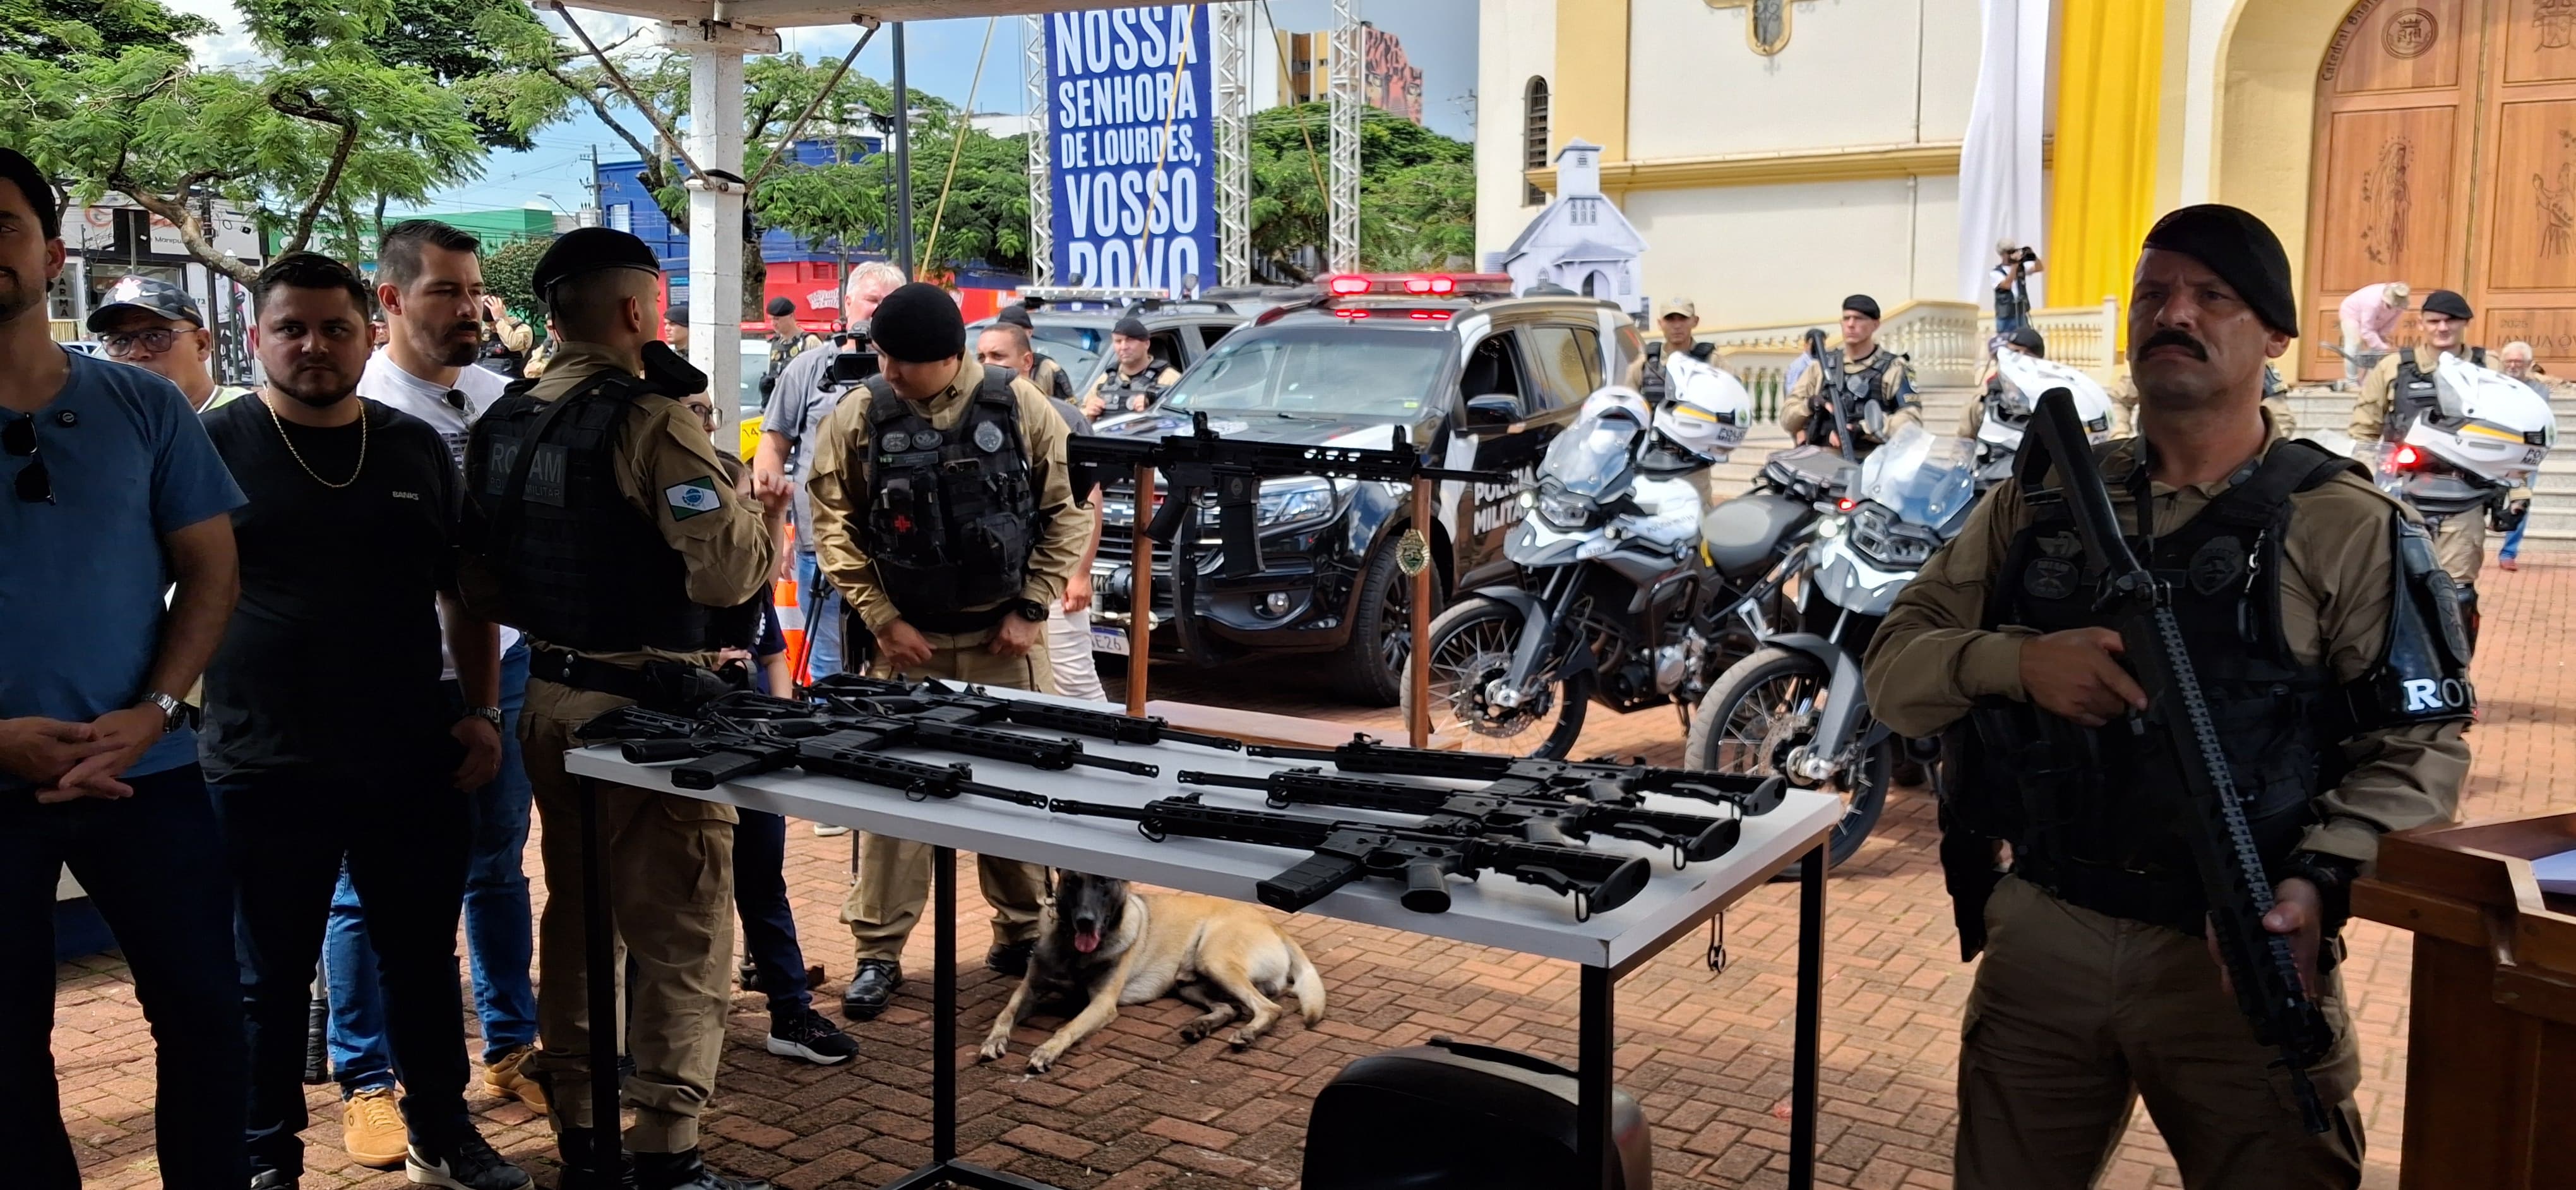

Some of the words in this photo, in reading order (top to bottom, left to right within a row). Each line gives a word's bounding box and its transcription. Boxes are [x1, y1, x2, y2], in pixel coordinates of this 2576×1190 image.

[1054, 4, 1198, 77] NOSSA
[2322, 29, 2351, 82] Catedral
[1059, 70, 1198, 129] SENHORA
[1061, 131, 1088, 169] DE
[1093, 124, 1202, 167] LOURDES,
[1065, 167, 1198, 237] VOSSO
[491, 442, 562, 484] ROAM
